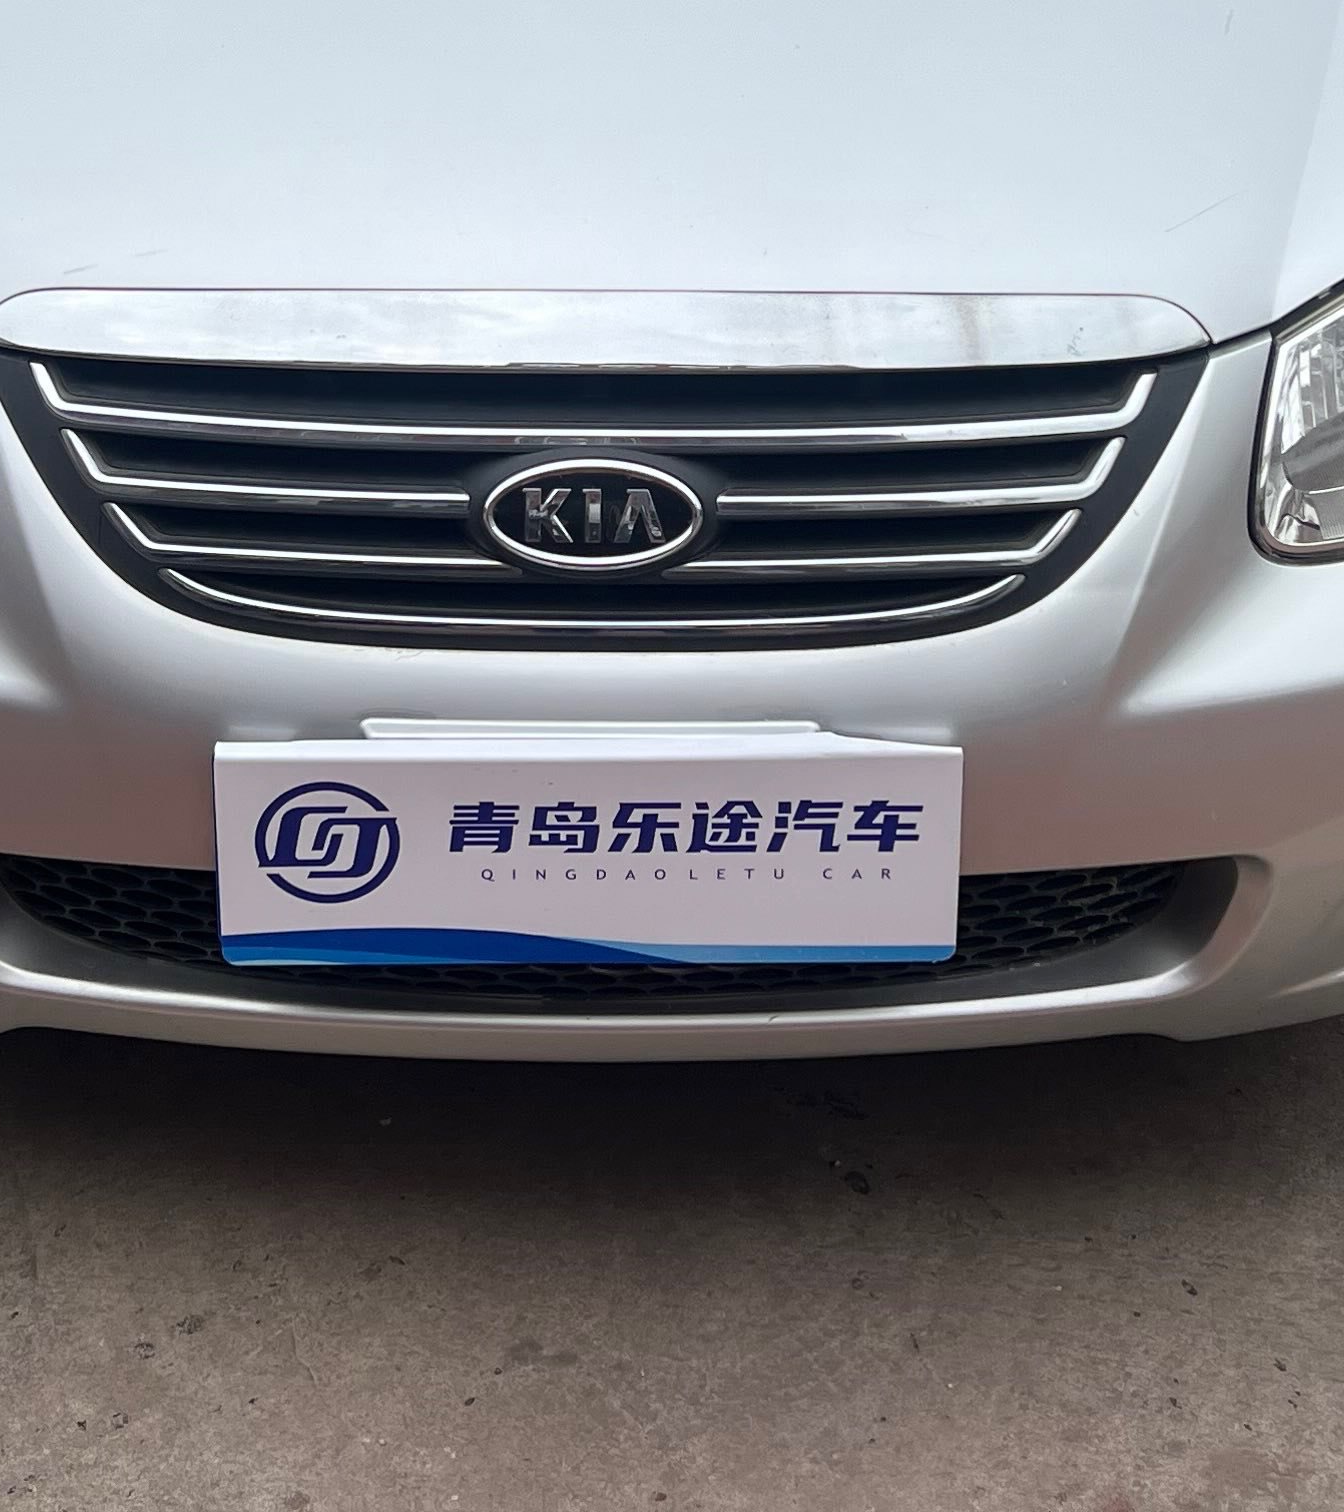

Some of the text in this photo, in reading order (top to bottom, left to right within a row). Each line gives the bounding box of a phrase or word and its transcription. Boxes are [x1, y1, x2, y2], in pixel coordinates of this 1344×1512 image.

[522, 488, 666, 544] KIA
[449, 800, 924, 854] 青岛乐途汽车
[480, 868, 892, 882] QINGDAOLETU CAR
